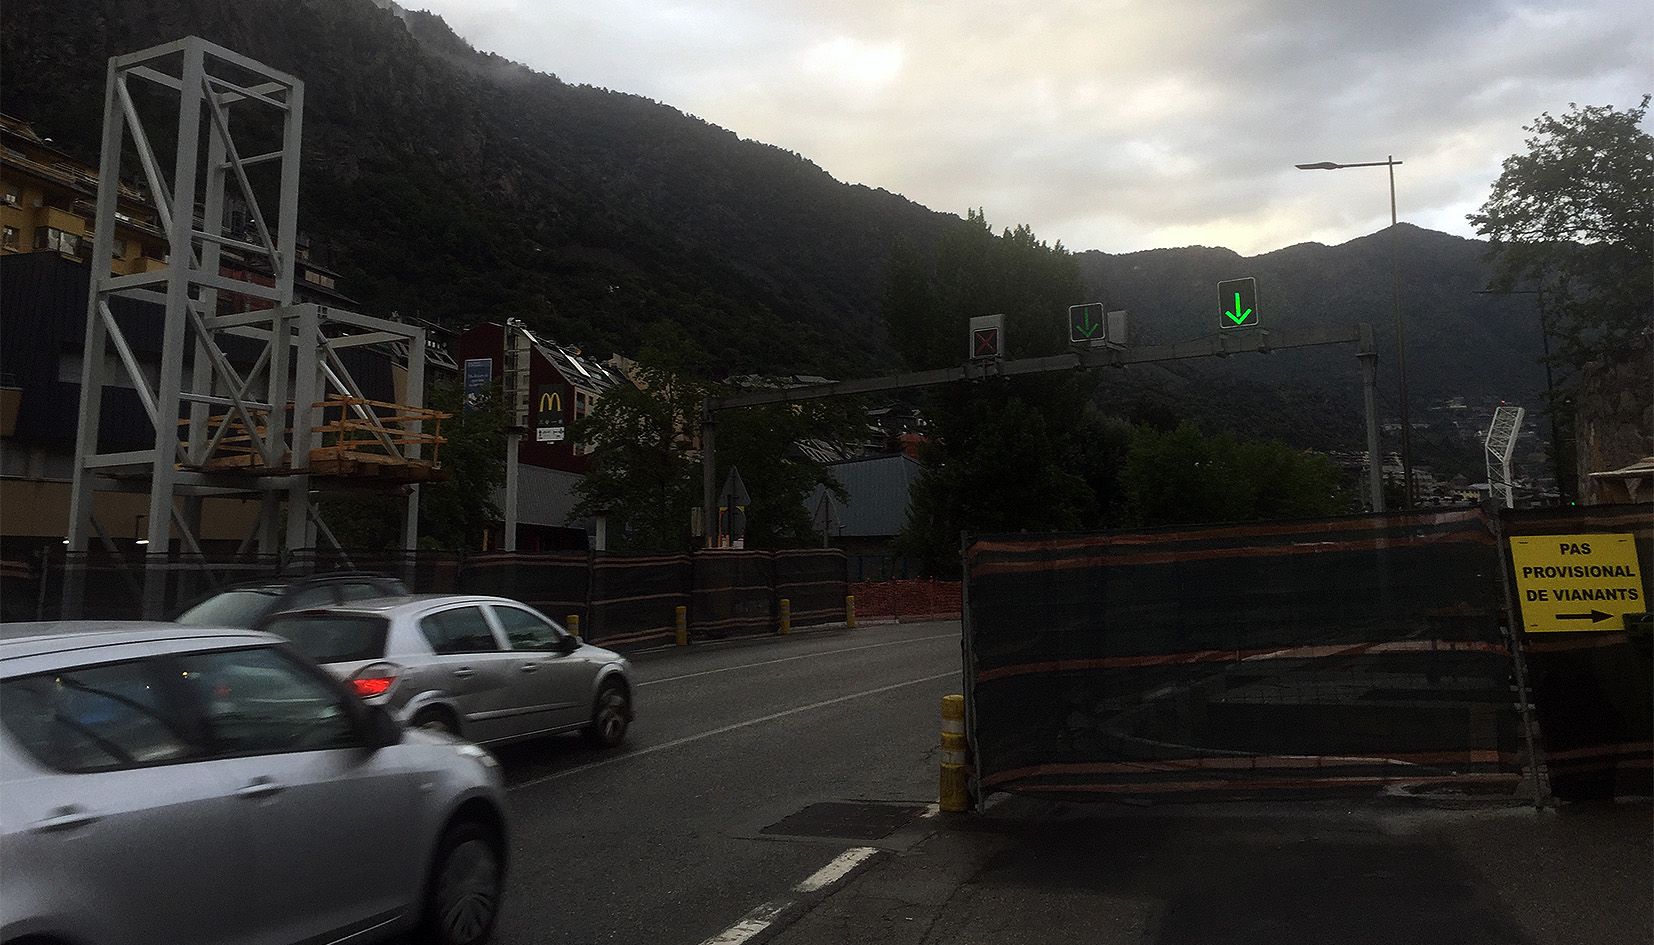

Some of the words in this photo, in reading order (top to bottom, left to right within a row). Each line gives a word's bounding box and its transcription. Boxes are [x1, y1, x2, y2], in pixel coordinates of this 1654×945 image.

[1559, 543, 1591, 555] PAS
[1523, 565, 1635, 578] PROVISIONAL
[1527, 589, 1549, 601] DE
[1553, 588, 1638, 601] VIANANTS
